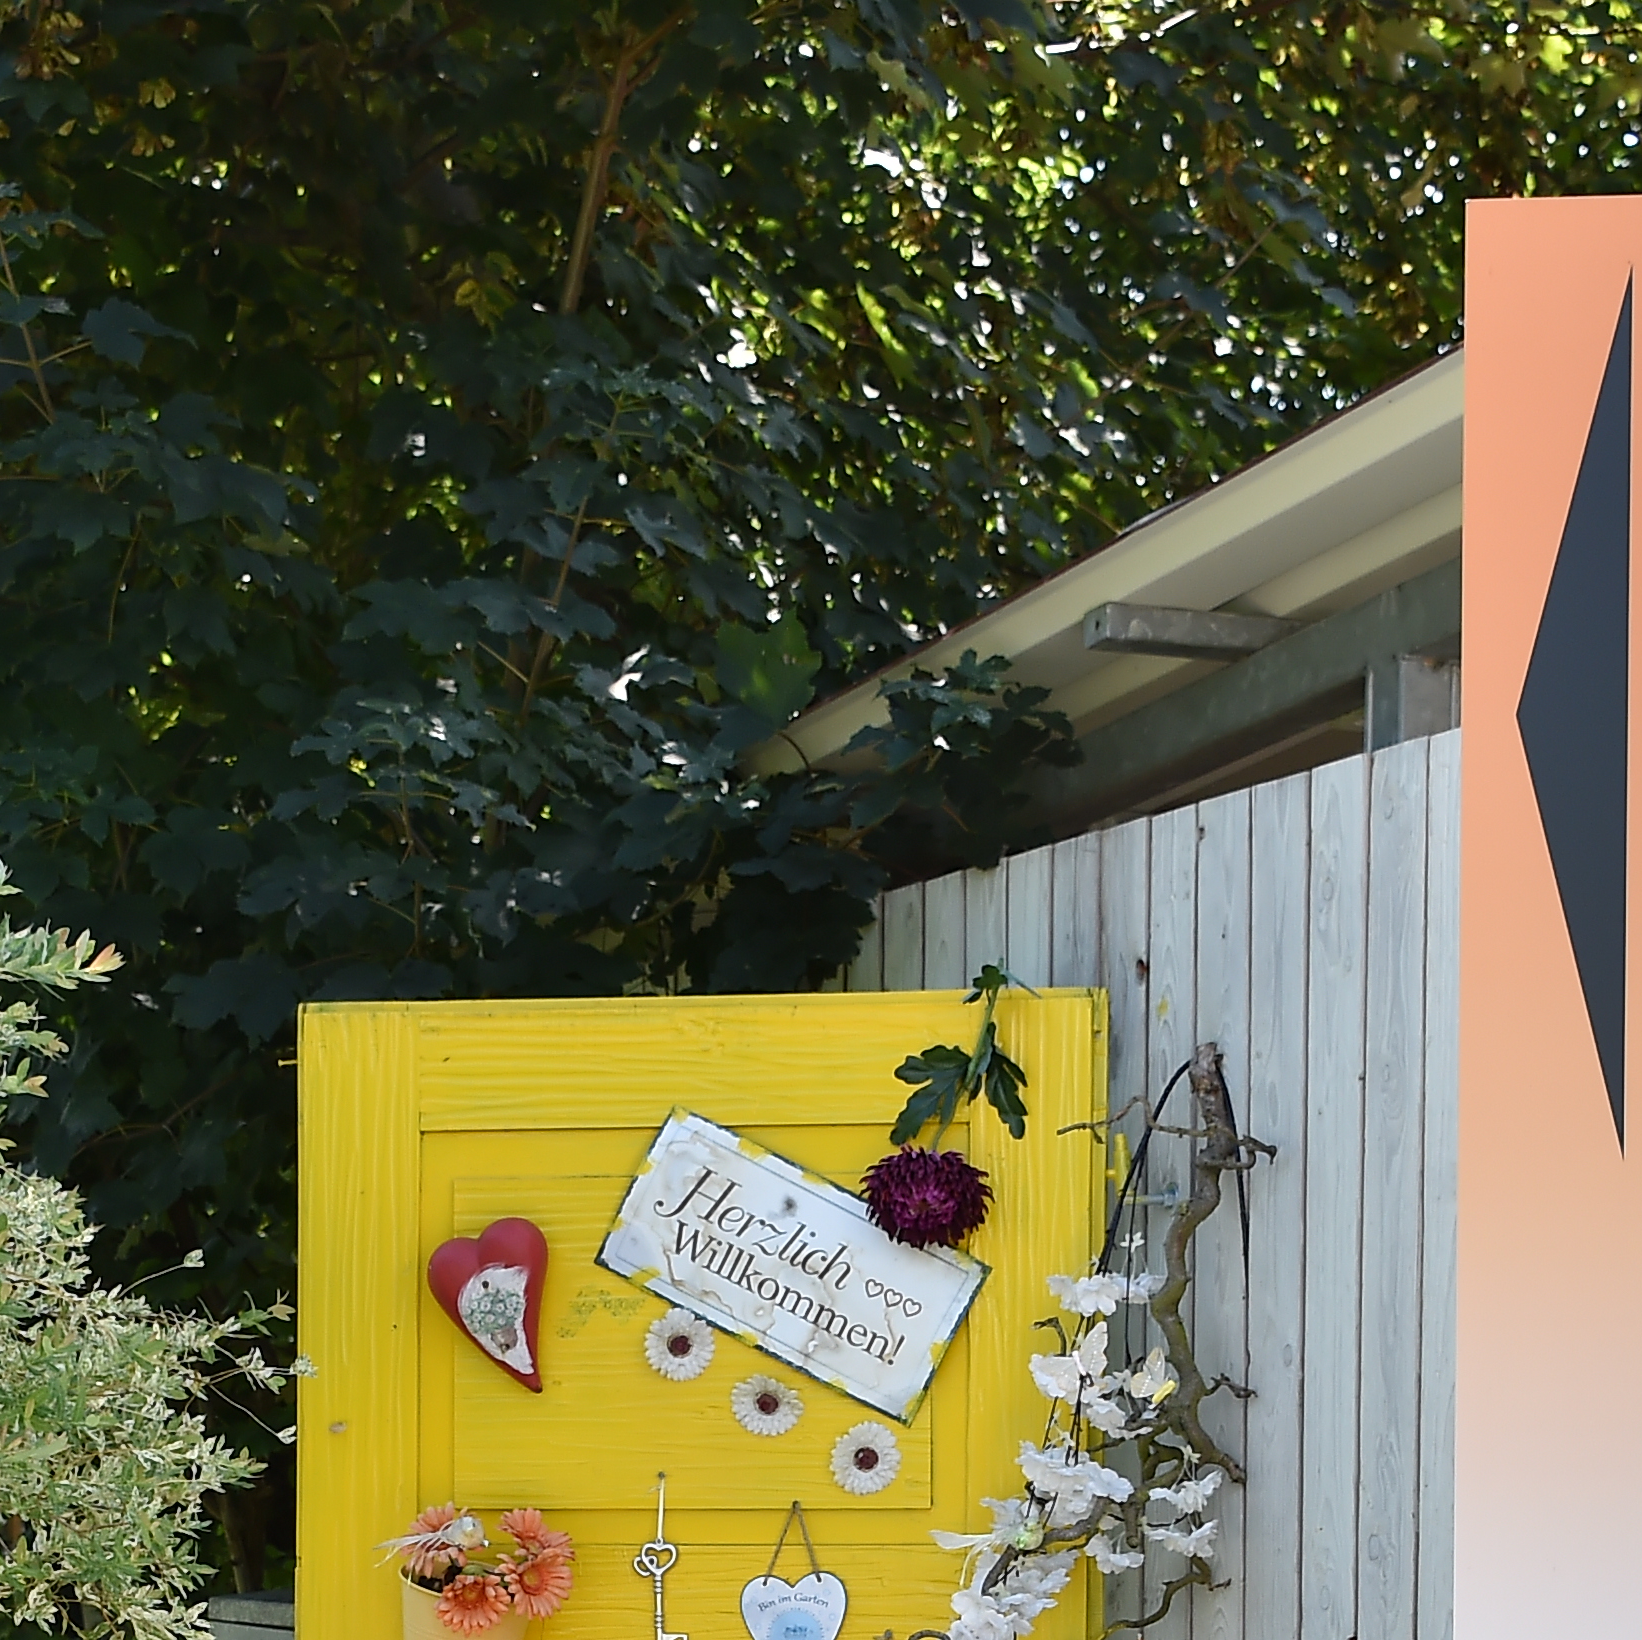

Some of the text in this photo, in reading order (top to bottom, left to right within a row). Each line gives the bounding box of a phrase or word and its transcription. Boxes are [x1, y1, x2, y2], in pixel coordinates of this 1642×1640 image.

[654, 1165, 852, 1291] Herzlich
[672, 1218, 906, 1367] Willkommen!
[757, 1592, 829, 1612] Bin im Garten
